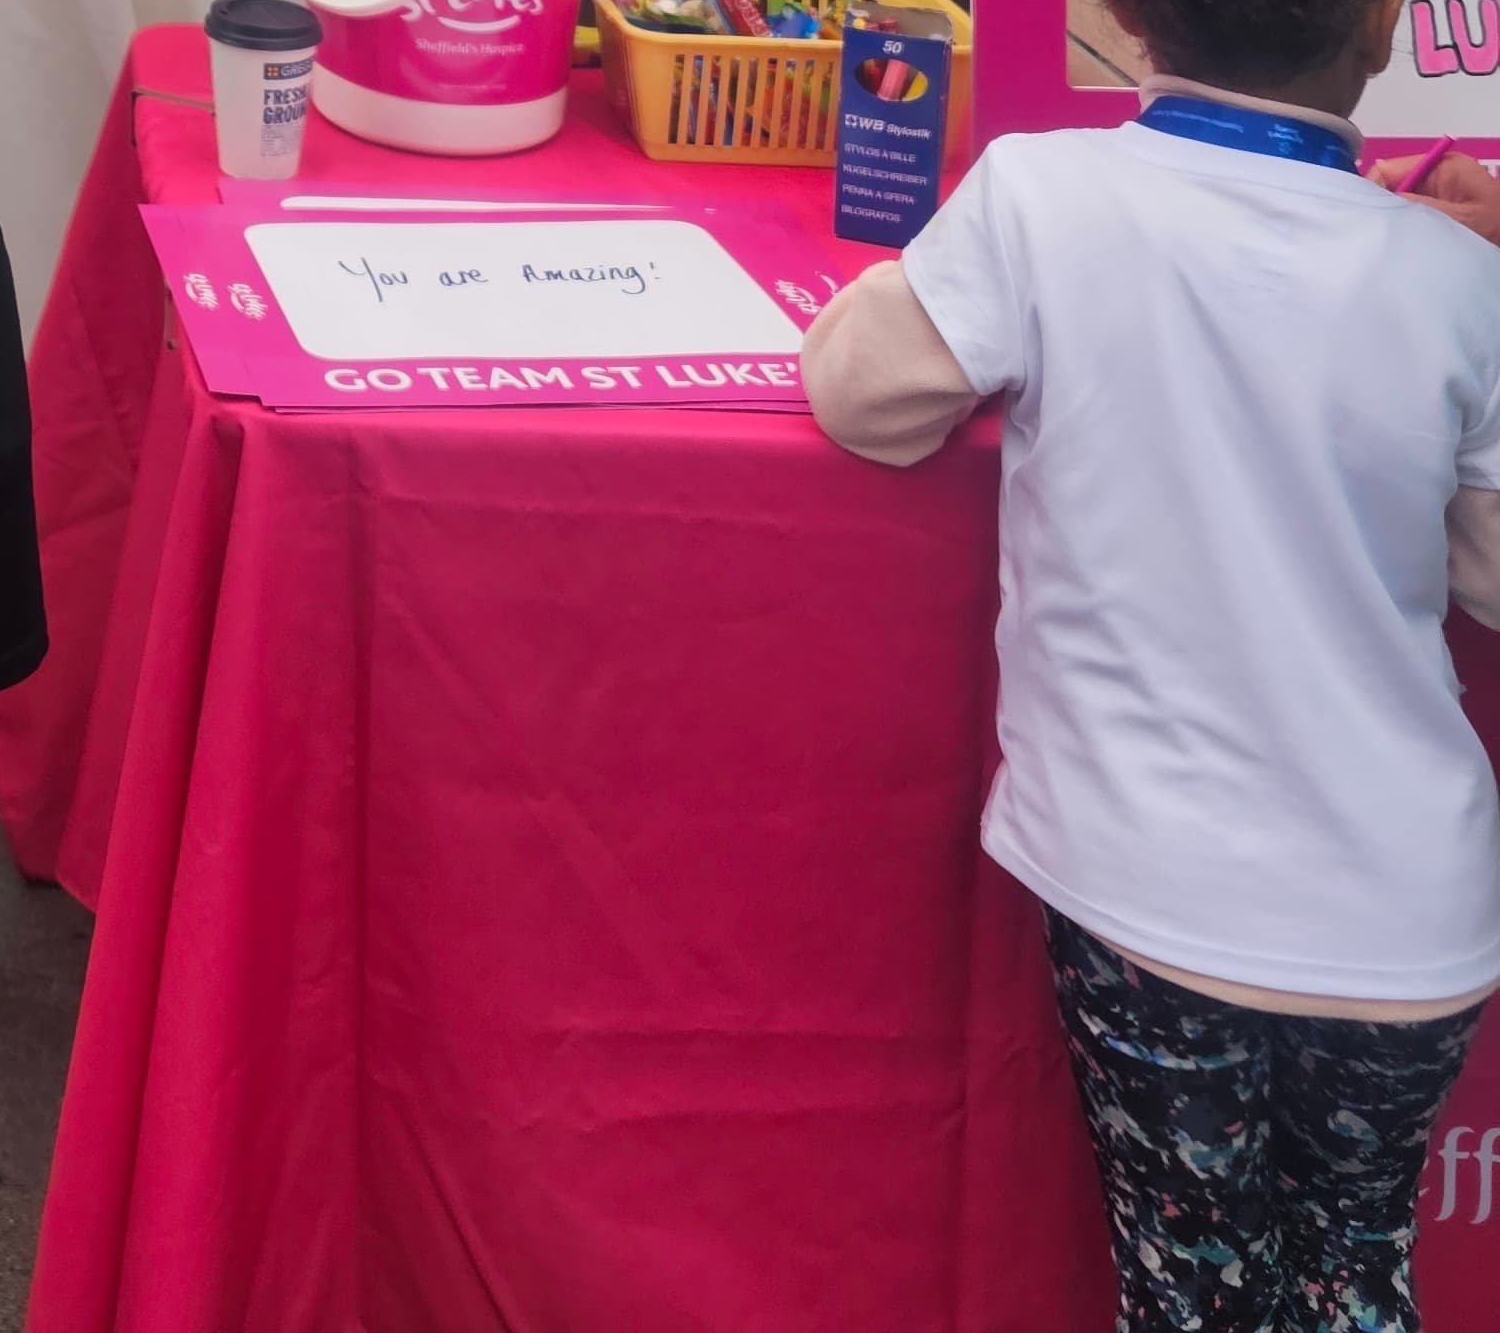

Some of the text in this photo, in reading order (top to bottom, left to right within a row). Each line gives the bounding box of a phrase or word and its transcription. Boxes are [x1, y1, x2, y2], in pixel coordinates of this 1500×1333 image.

[415, 37, 479, 55] Sheffield's
[882, 39, 904, 55] 50
[337, 257, 409, 303] You
[438, 265, 489, 287] are
[324, 362, 799, 393] GO TEAM ST LUKE'
